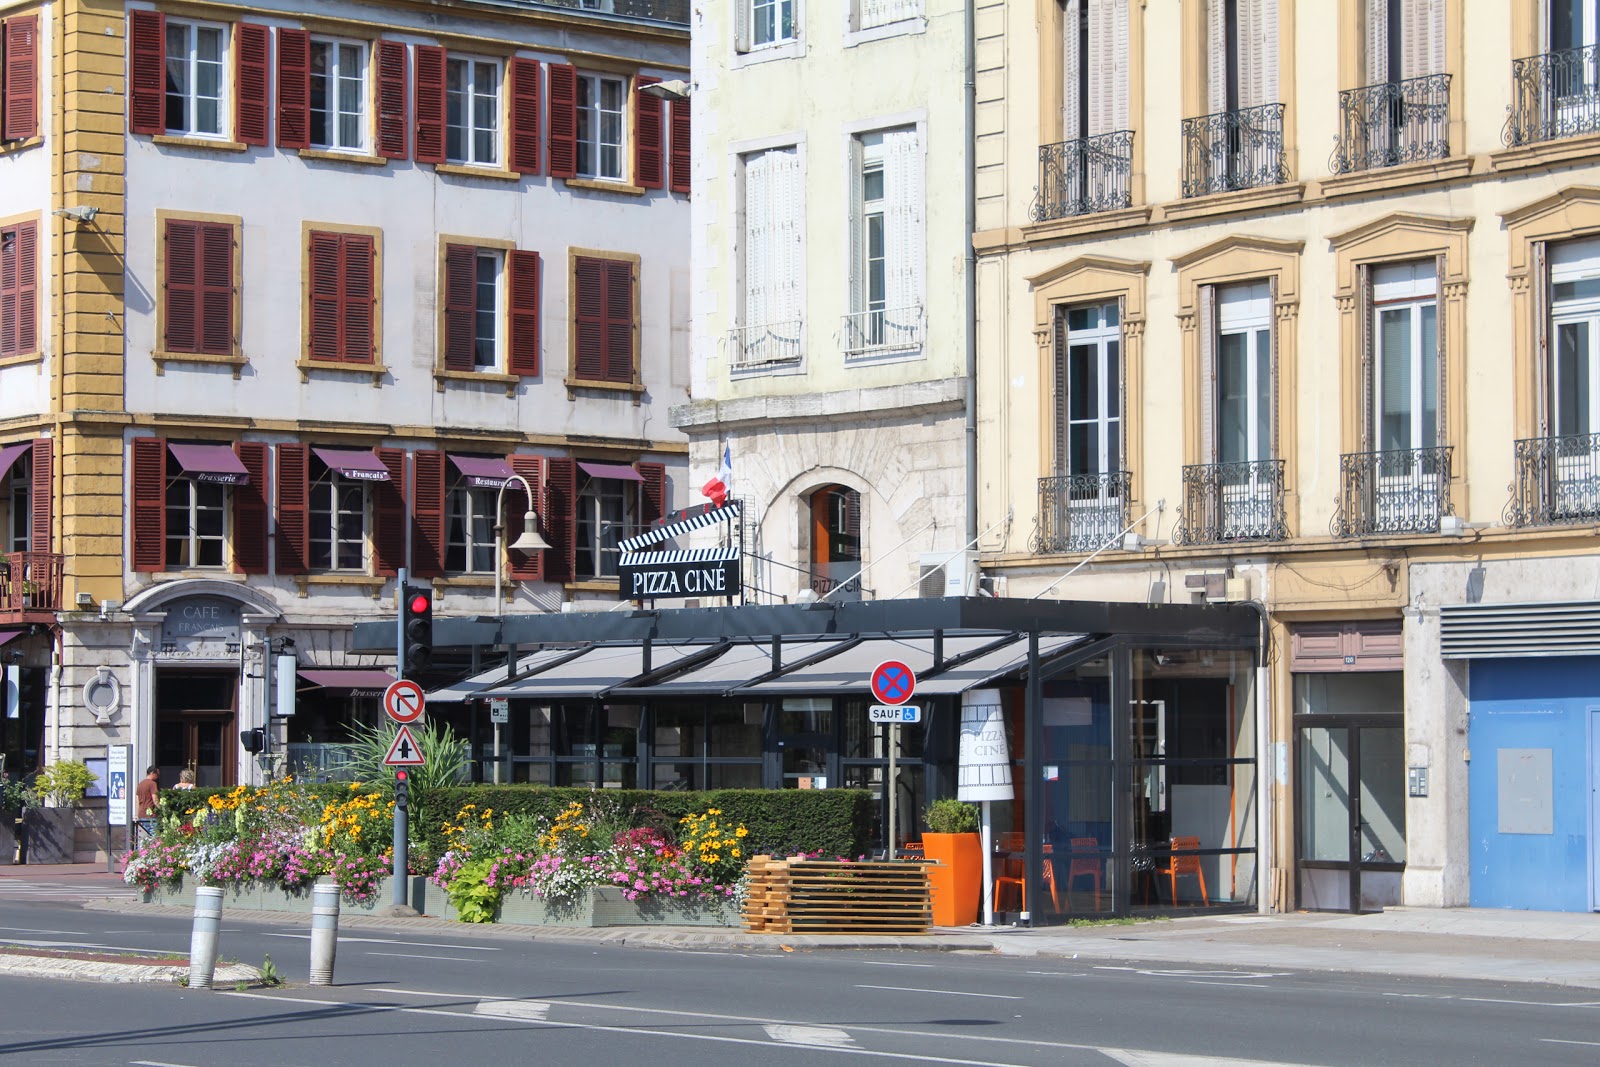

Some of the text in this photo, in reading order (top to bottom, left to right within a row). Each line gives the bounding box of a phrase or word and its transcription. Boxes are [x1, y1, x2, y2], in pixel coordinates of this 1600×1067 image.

[197, 473, 236, 483] Brasserie
[632, 561, 726, 594] PIZZA CINÉ
[350, 688, 386, 697] Brasseri
[873, 709, 901, 719] SAUF
[973, 729, 1004, 742] PIZZA
[974, 741, 1006, 756] CINÉ
